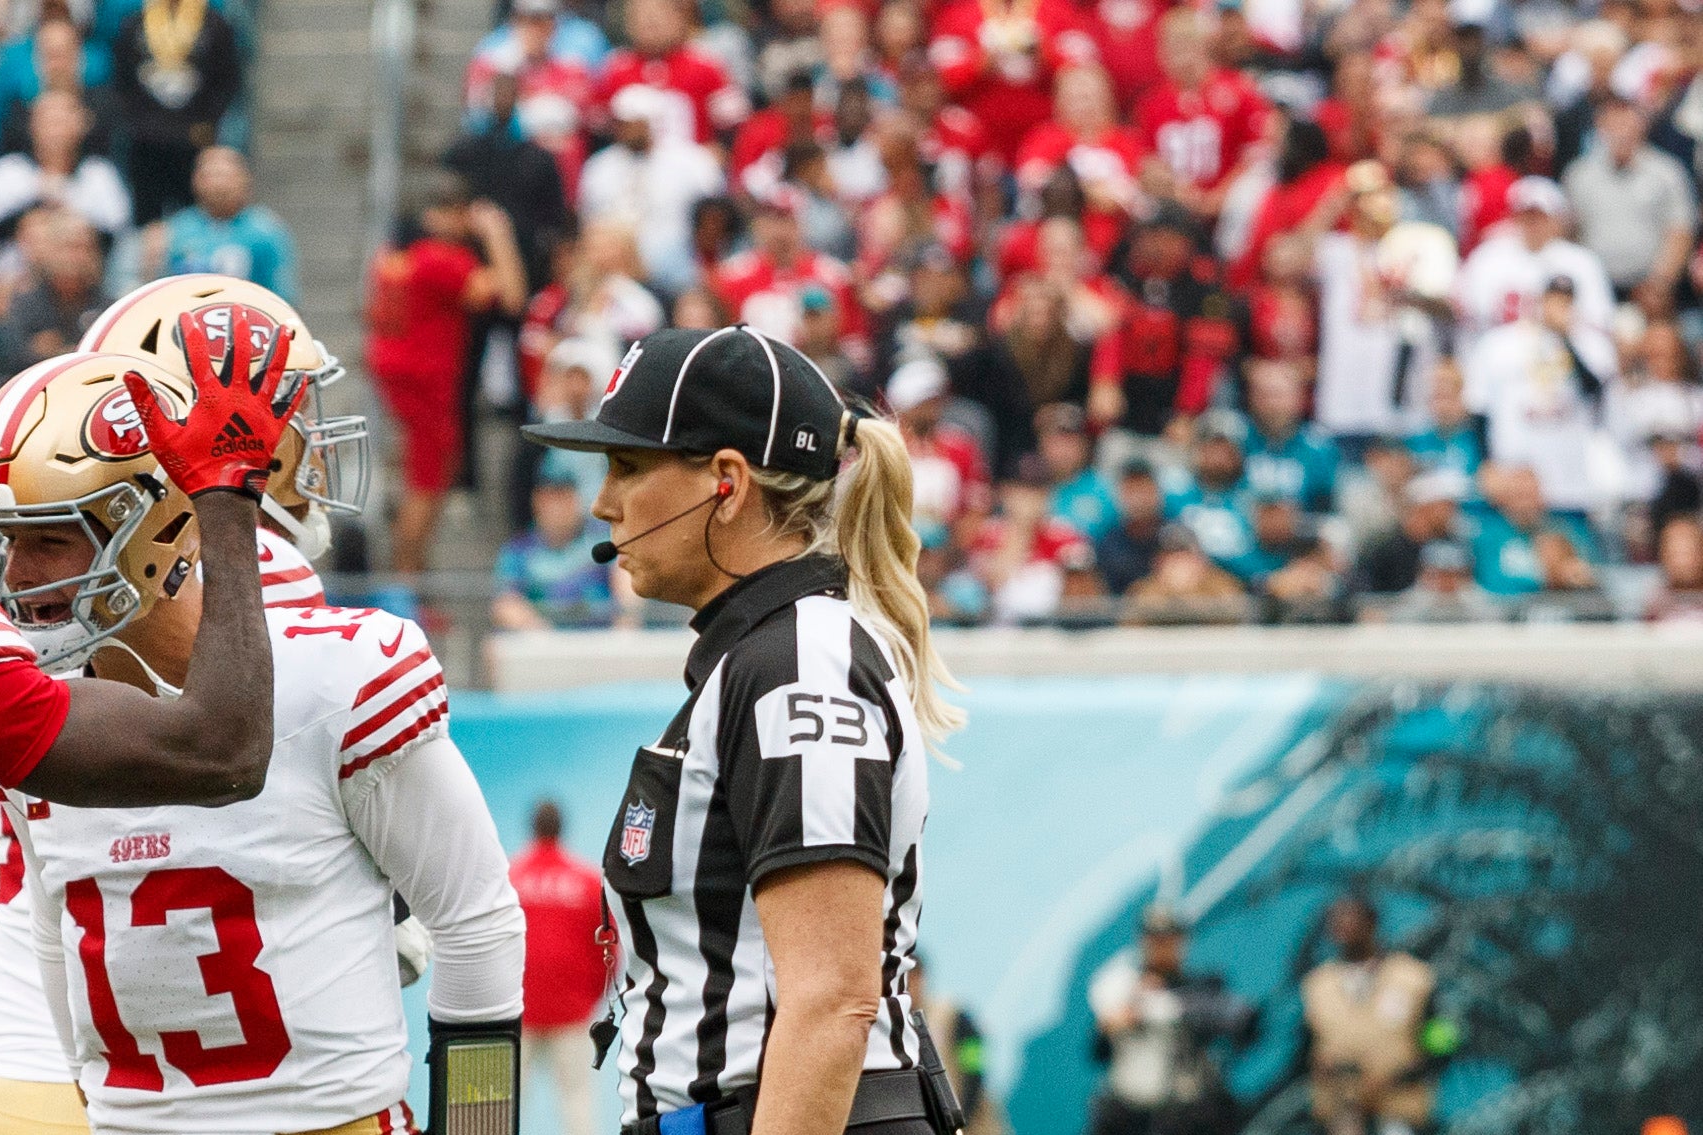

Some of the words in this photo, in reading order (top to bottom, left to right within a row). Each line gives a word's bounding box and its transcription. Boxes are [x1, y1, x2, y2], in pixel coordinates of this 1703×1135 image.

[210, 437, 266, 458] adidas
[795, 430, 817, 451] BL
[786, 692, 869, 747] 53
[108, 833, 172, 863] 49ERS
[622, 826, 646, 857] NFL
[65, 866, 293, 1093] 13
